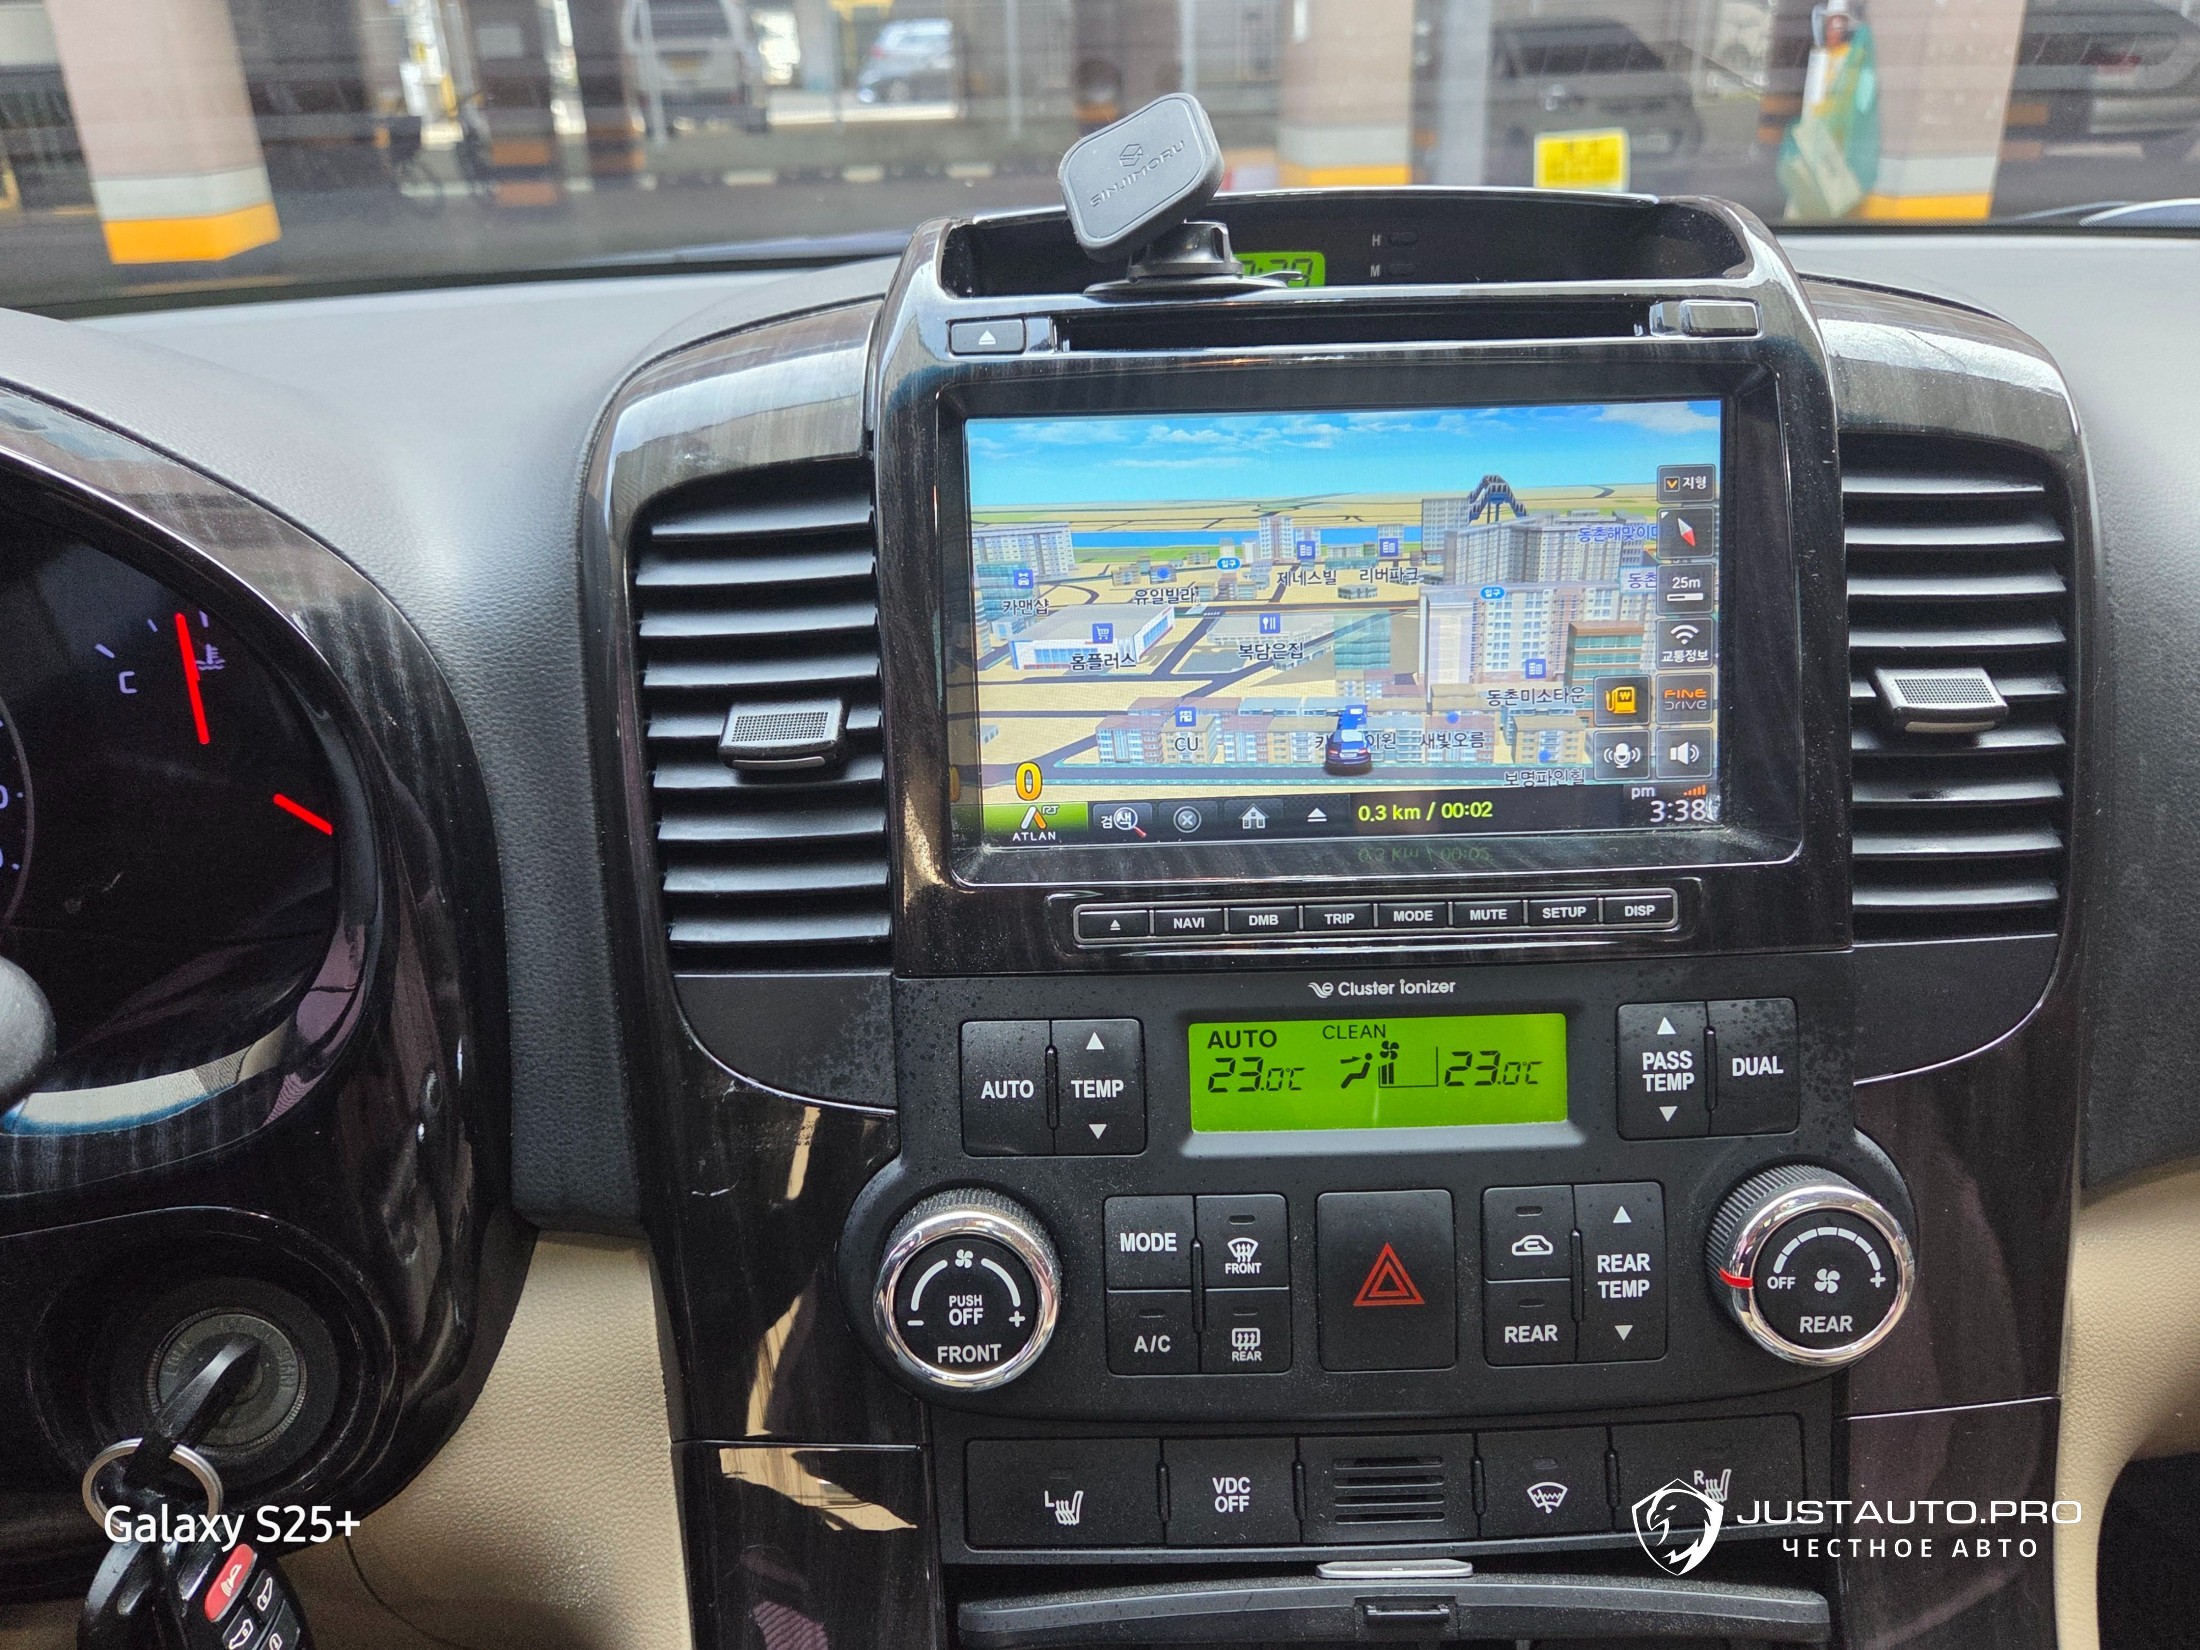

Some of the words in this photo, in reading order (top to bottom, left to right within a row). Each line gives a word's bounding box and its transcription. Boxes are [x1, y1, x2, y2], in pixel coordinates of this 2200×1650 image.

[1090, 140, 1186, 207] SINJIMORU
[1371, 234, 1381, 247] H
[1370, 264, 1381, 277] M
[1682, 475, 1707, 490] 지형
[1276, 570, 1337, 586] 제네스빌
[1359, 567, 1420, 583] 리버파크
[1672, 576, 1700, 589] 25m
[1134, 588, 1196, 604] 유일빌라
[1002, 599, 1049, 616] 카맨샵
[1238, 642, 1304, 661] 복담은집
[1661, 649, 1709, 663] 교통정보
[1070, 653, 1137, 671] 홈플러스
[118, 670, 138, 694] C
[1486, 687, 1586, 706] 동촌미소타운
[1664, 688, 1707, 699] FINE
[1174, 736, 1199, 752] CU
[1420, 731, 1485, 750] 새빛오름
[1015, 761, 1043, 801] 0
[1631, 786, 1656, 800] pm
[1358, 804, 1388, 822] 0.3
[1392, 804, 1421, 821] km
[1426, 801, 1437, 821] /
[1441, 801, 1494, 819] 00:02
[1649, 798, 1707, 823] 3:38
[1100, 811, 1133, 830] 검색
[1012, 831, 1057, 842] ATLAN
[1324, 913, 1355, 924] TRIP
[1393, 910, 1433, 922] MODE
[1469, 908, 1508, 920] MUTE
[1542, 906, 1587, 919] SETUP
[1624, 905, 1656, 916] DISP
[1173, 918, 1205, 929] NAVI
[1248, 915, 1279, 926] DMB
[1338, 981, 1395, 996] Cluster
[1399, 979, 1456, 994] Ionizer
[1207, 1029, 1278, 1050] AUTO
[1322, 1024, 1387, 1041] CLEAN
[1642, 1050, 1693, 1071] PASS
[1732, 1056, 1784, 1077] DUAL
[980, 1079, 1035, 1100] AUTO
[1070, 1079, 1124, 1099] TEMP
[1642, 1072, 1695, 1092] TEMP
[1119, 1232, 1177, 1254] MODE
[1225, 1262, 1262, 1275] FRONT
[1597, 1253, 1650, 1273] REAR
[1598, 1279, 1650, 1300] TEMP
[1767, 1276, 1796, 1290] OFF
[948, 1294, 983, 1309] PUSH
[948, 1308, 984, 1326] OFF
[1800, 1315, 1853, 1334] REAR
[1504, 1324, 1558, 1344] REAR
[1134, 1334, 1171, 1354] A/C
[937, 1343, 1002, 1364] FRONT
[1231, 1349, 1262, 1362] REAR
[1212, 1476, 1250, 1494] VDC
[1694, 1470, 1705, 1485] R
[1214, 1496, 1250, 1513] OFF
